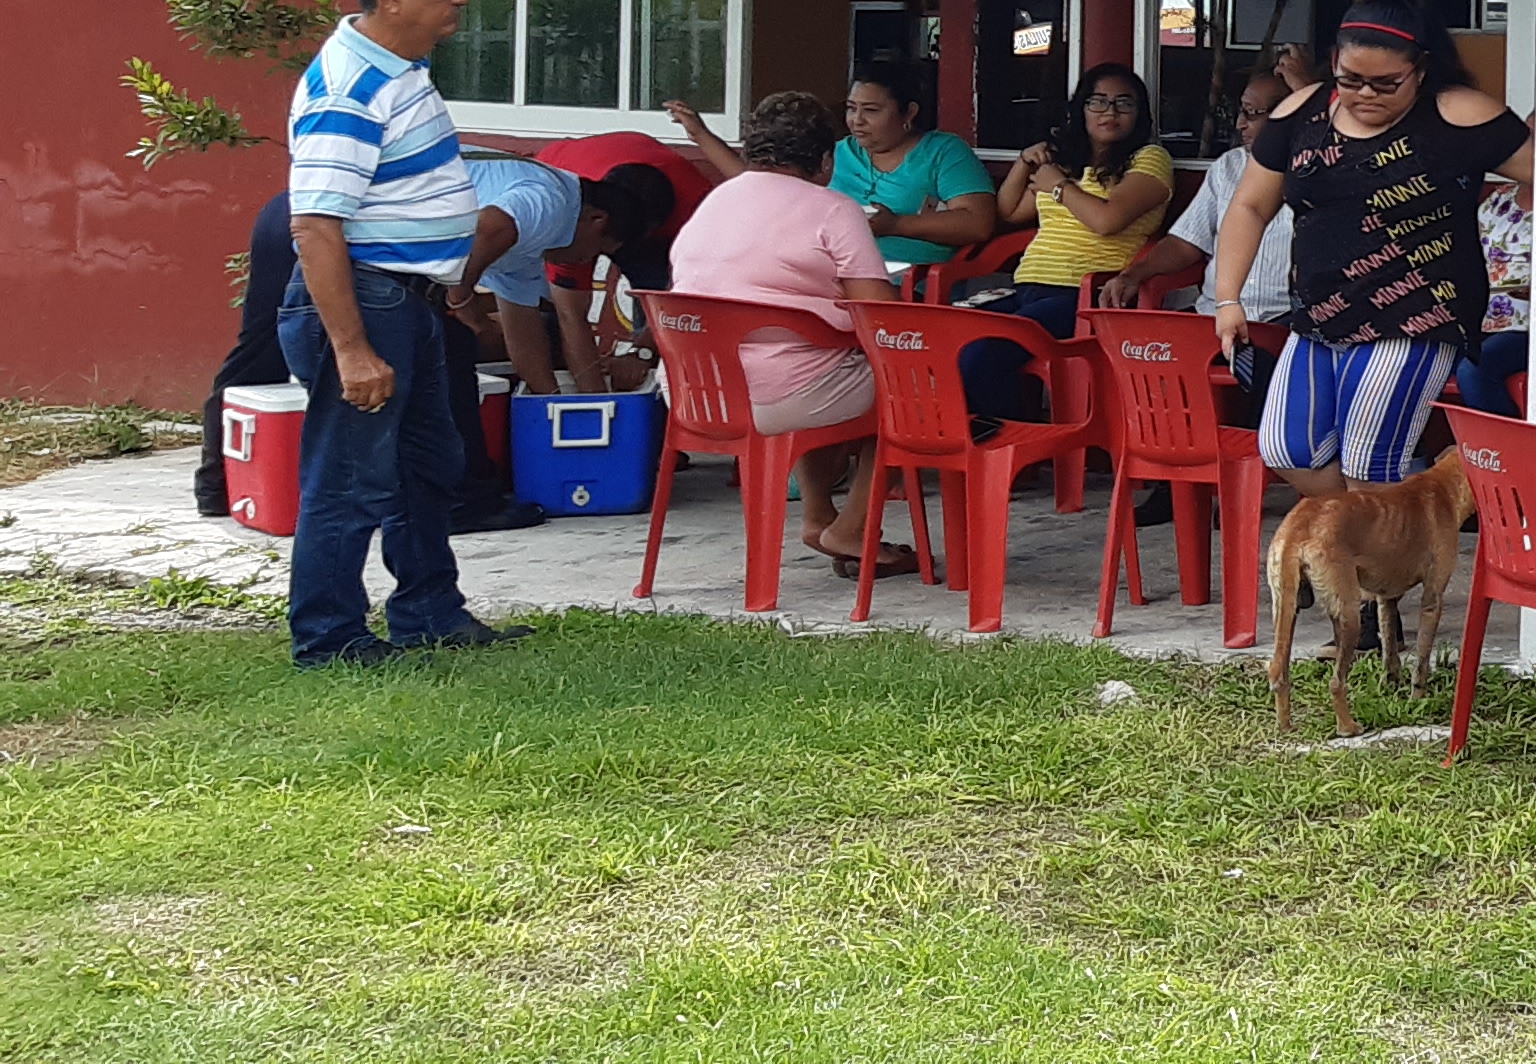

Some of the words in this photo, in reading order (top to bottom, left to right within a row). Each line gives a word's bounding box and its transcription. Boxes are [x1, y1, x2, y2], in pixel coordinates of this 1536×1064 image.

[1386, 202, 1452, 240] MINNIE
[1341, 239, 1406, 282] MINNIE
[1369, 268, 1430, 310] MINNIE
[1399, 302, 1457, 338] MINNIE
